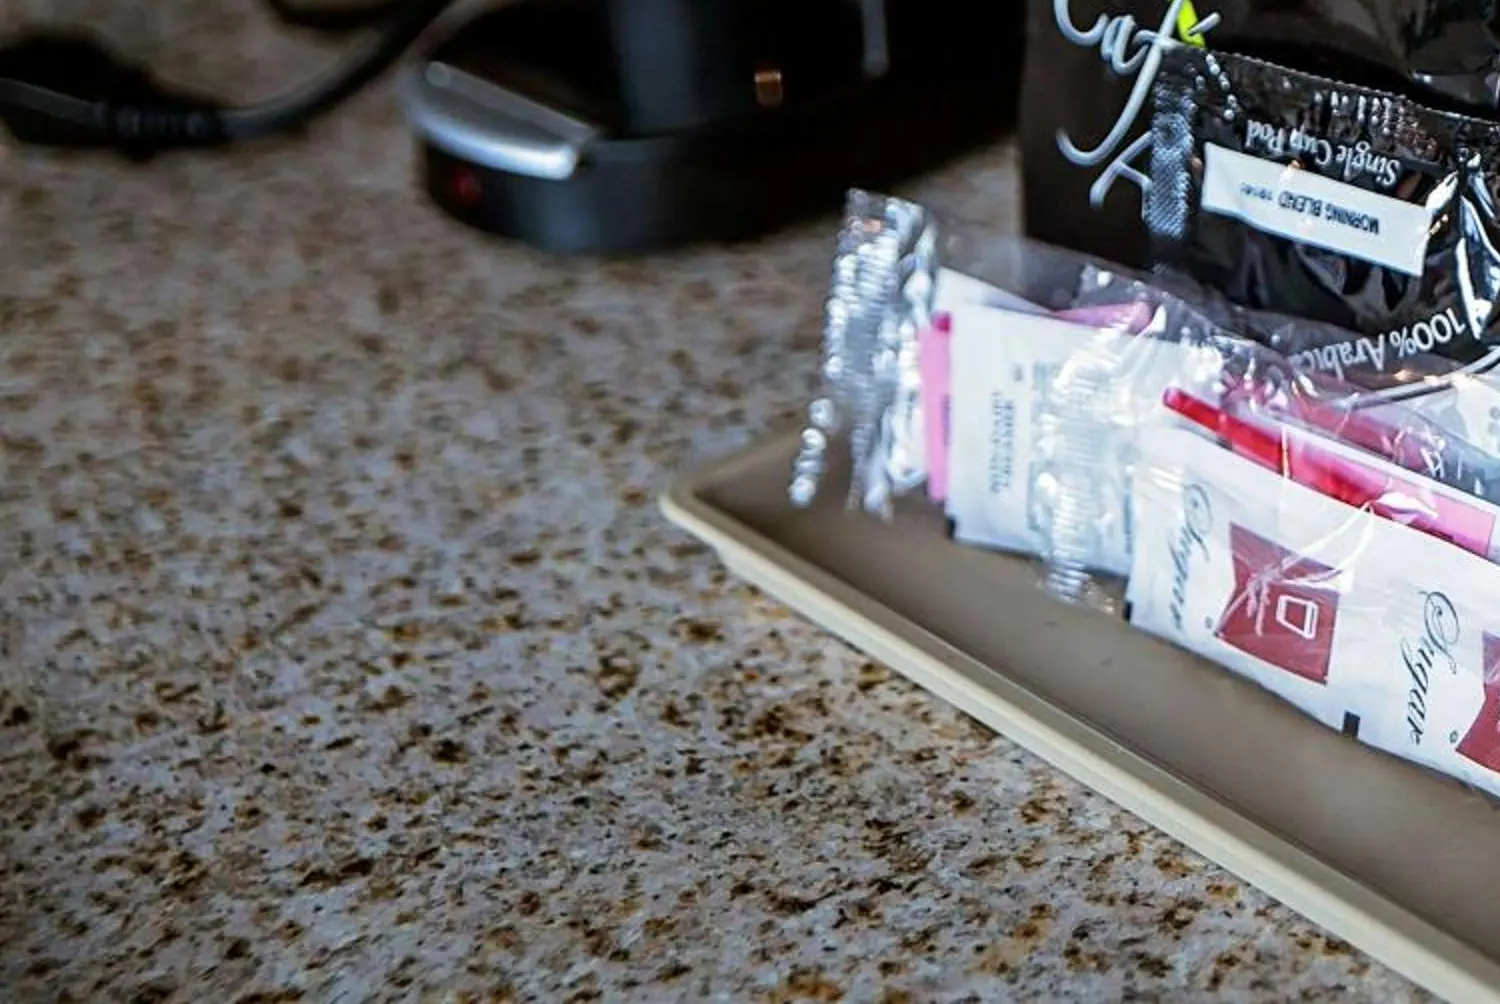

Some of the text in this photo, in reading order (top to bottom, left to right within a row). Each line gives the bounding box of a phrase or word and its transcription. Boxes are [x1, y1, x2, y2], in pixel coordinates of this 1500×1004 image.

[1244, 119, 1401, 187] Single Cup Pod
[1278, 190, 1322, 217] BLEND
[1325, 202, 1380, 235] MORNING
[1389, 308, 1466, 357] 100%
[1168, 482, 1213, 630] Sugar
[1401, 590, 1461, 746] Sugar
